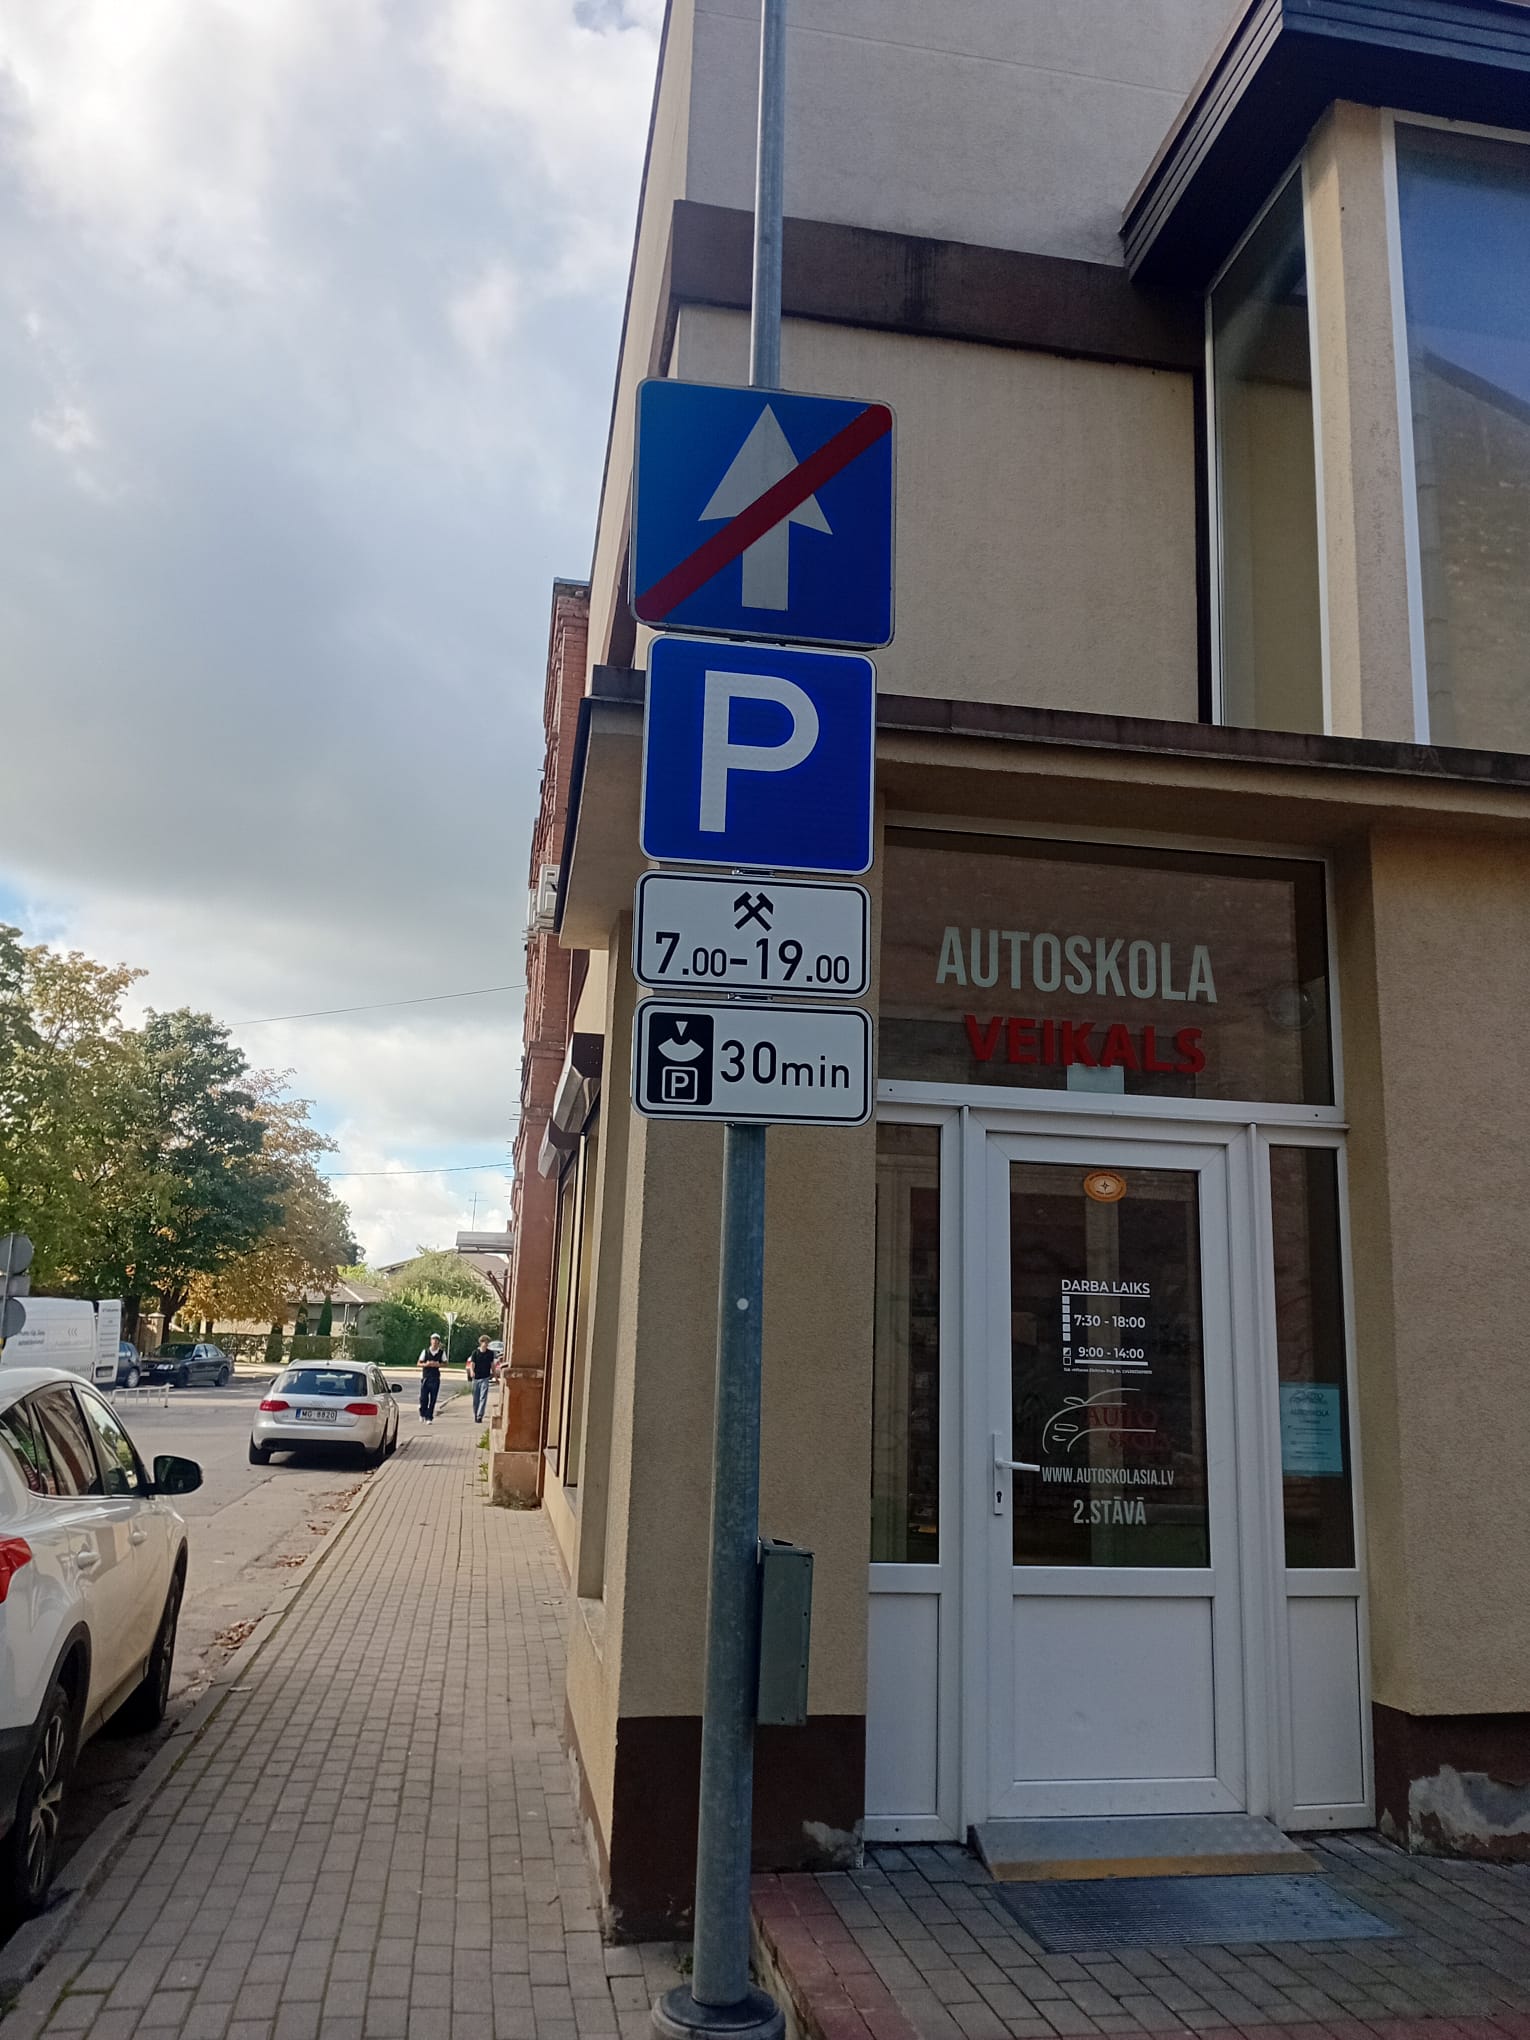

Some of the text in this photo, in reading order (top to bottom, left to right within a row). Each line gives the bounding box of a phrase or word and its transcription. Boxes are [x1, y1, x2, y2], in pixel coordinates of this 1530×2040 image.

[699, 669, 820, 833] P
[935, 926, 1218, 1004] AUTOSKOLA
[964, 1014, 1206, 1074] VEIKALS
[671, 1071, 689, 1098] P
[1061, 1279, 1151, 1294] DARBA LAIKS
[1073, 1315, 1101, 1327] 7:30
[1112, 1316, 1146, 1329] 18:00
[1078, 1347, 1104, 1358] 9:00
[1114, 1347, 1145, 1359] 14:00
[1042, 1466, 1175, 1486] WWW.AUTOSKOLASIA.LV
[1073, 1496, 1147, 1525] 2.STĀVĀ
